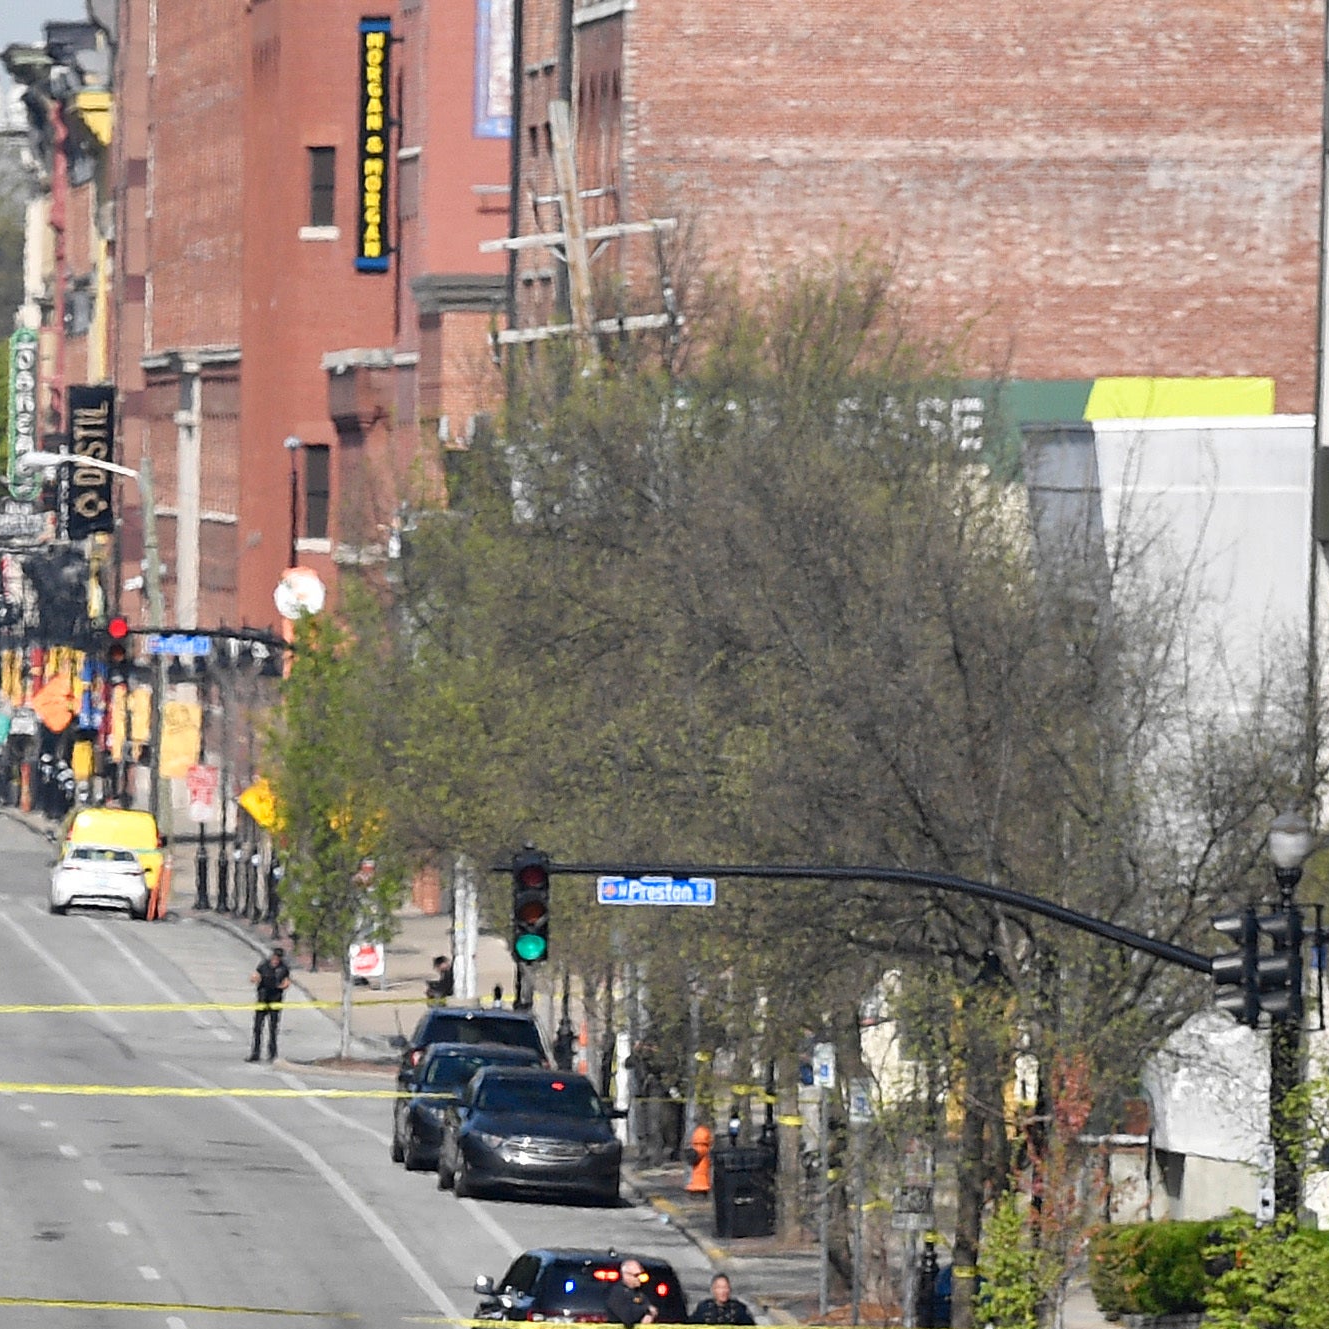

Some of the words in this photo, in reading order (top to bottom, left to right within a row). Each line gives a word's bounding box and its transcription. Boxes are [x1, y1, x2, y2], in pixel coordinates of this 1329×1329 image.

[366, 32, 385, 131] MORGAN
[365, 135, 384, 154] &
[364, 157, 384, 258] MORGAN
[628, 881, 694, 901] Preston
